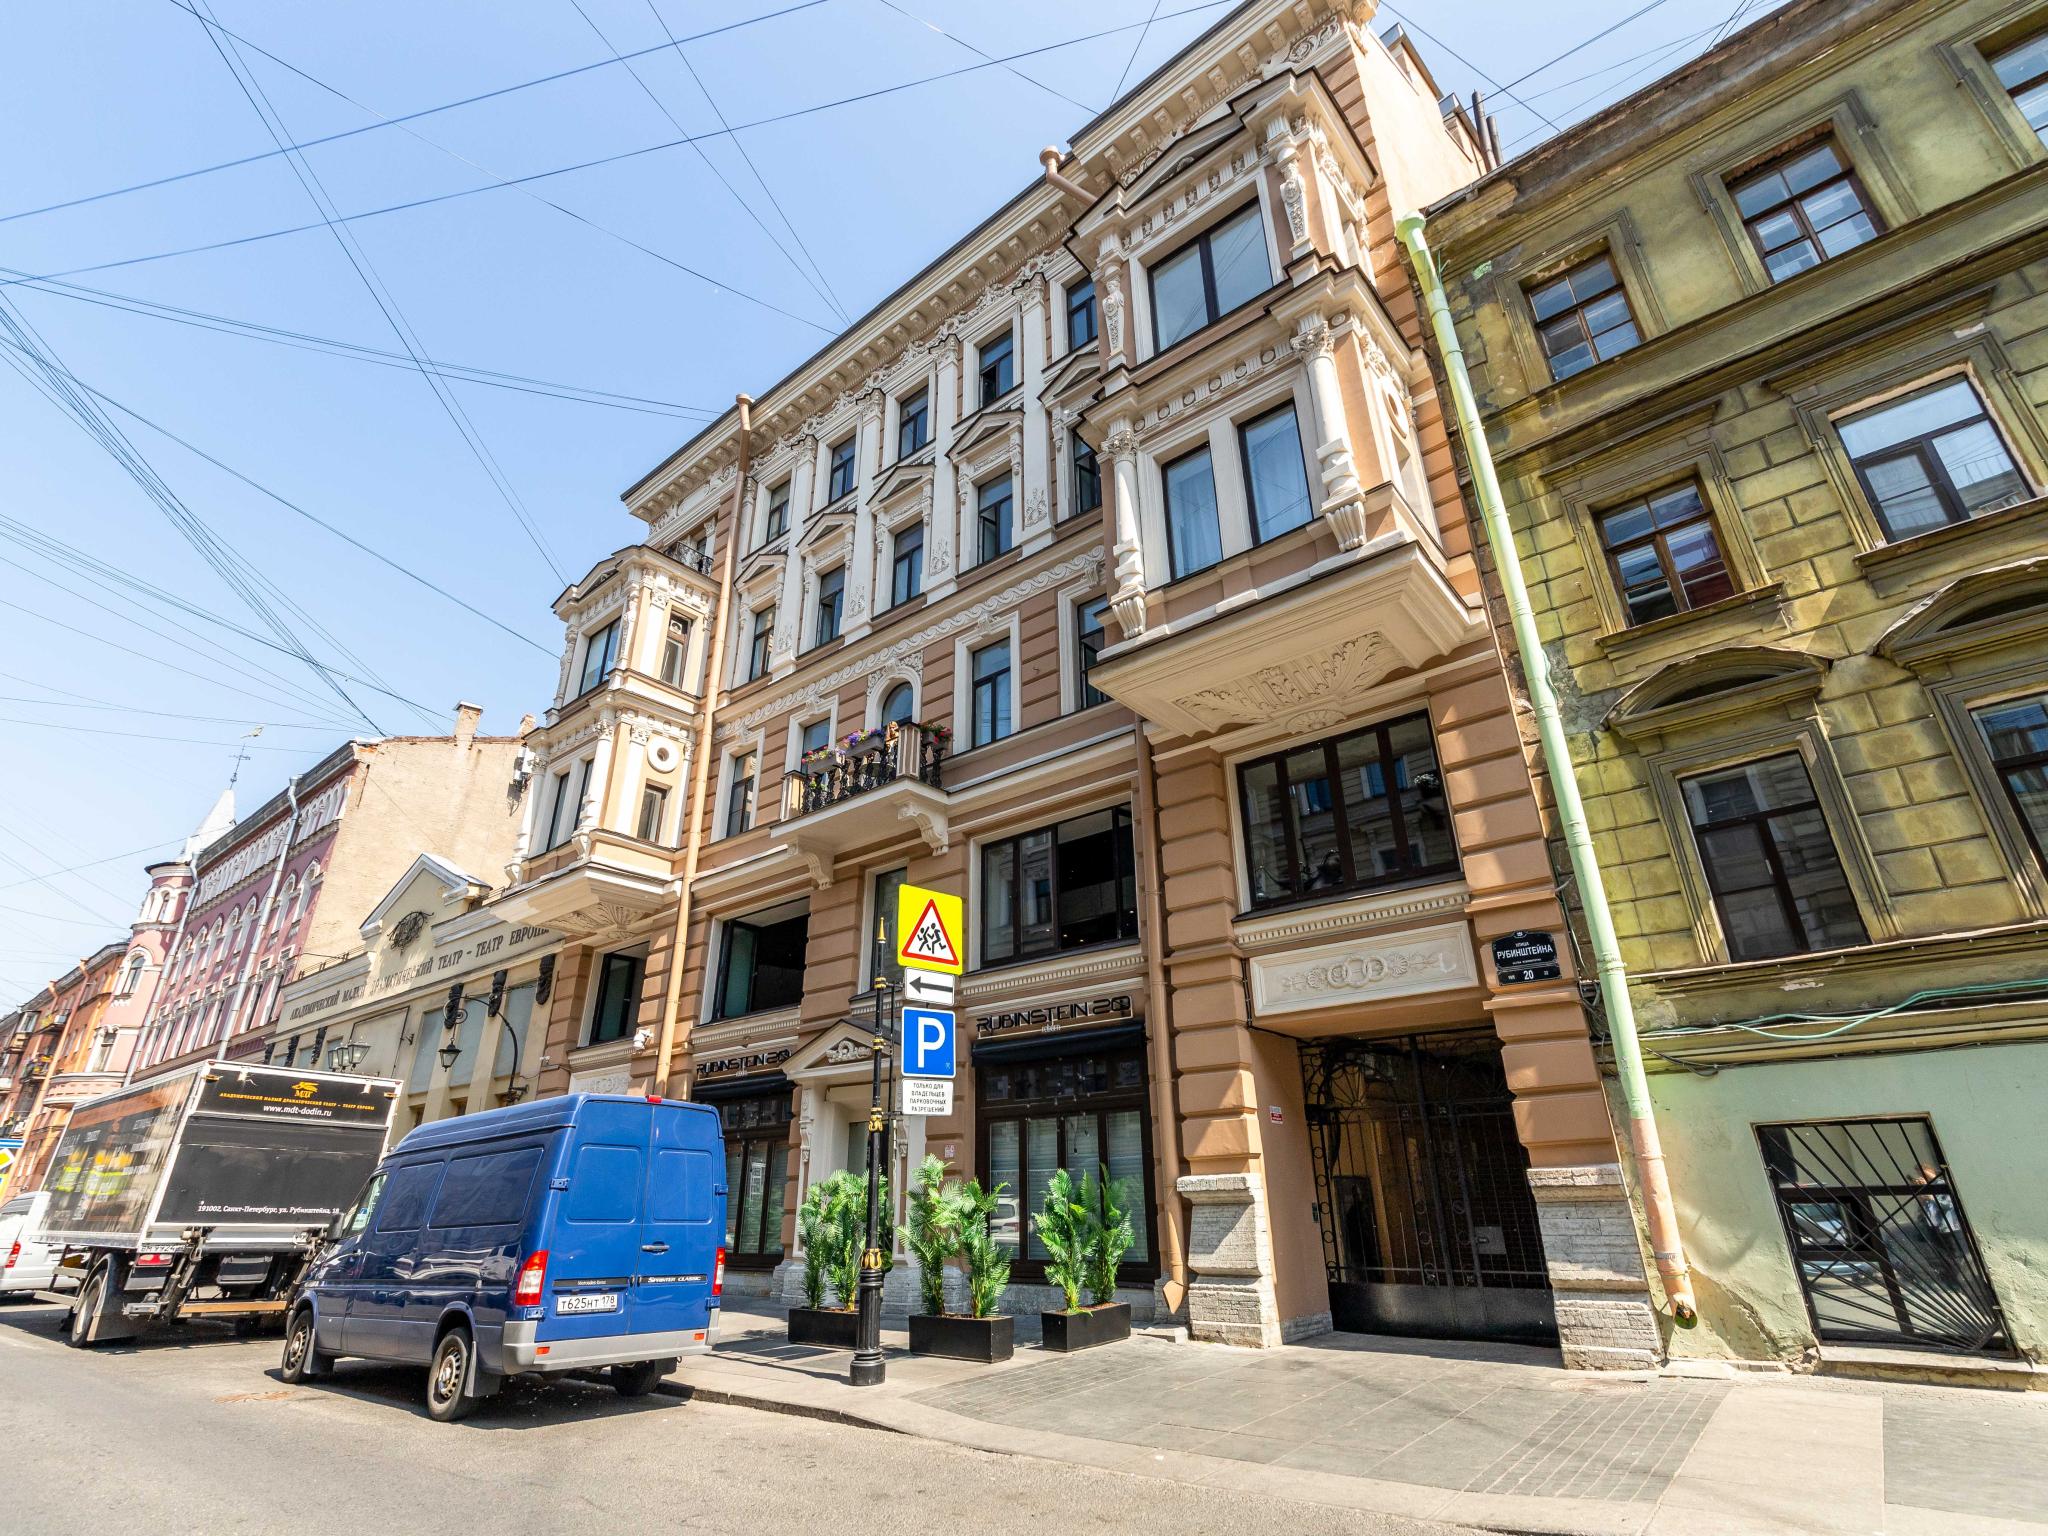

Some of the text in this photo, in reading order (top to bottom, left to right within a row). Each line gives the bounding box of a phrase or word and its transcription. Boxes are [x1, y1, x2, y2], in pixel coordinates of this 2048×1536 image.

[438, 949, 464, 970] ТЕАТР
[475, 935, 504, 958] ТЕАТР
[1496, 944, 1554, 960] РУБИНШТЕЙНА
[1523, 969, 1534, 980] 20
[977, 1001, 1089, 1032] RUBINSTEIN
[917, 1016, 946, 1068] P
[911, 1090, 945, 1098] ВЛАДЕЛЬЦЕВ
[909, 1097, 947, 1105] ПАРКОВОЧНЫХ
[263, 1104, 332, 1117] www.mdt-dodin.ru
[911, 1105, 945, 1113] РАЗРЕШЕНИЙ
[602, 1295, 615, 1305] 178
